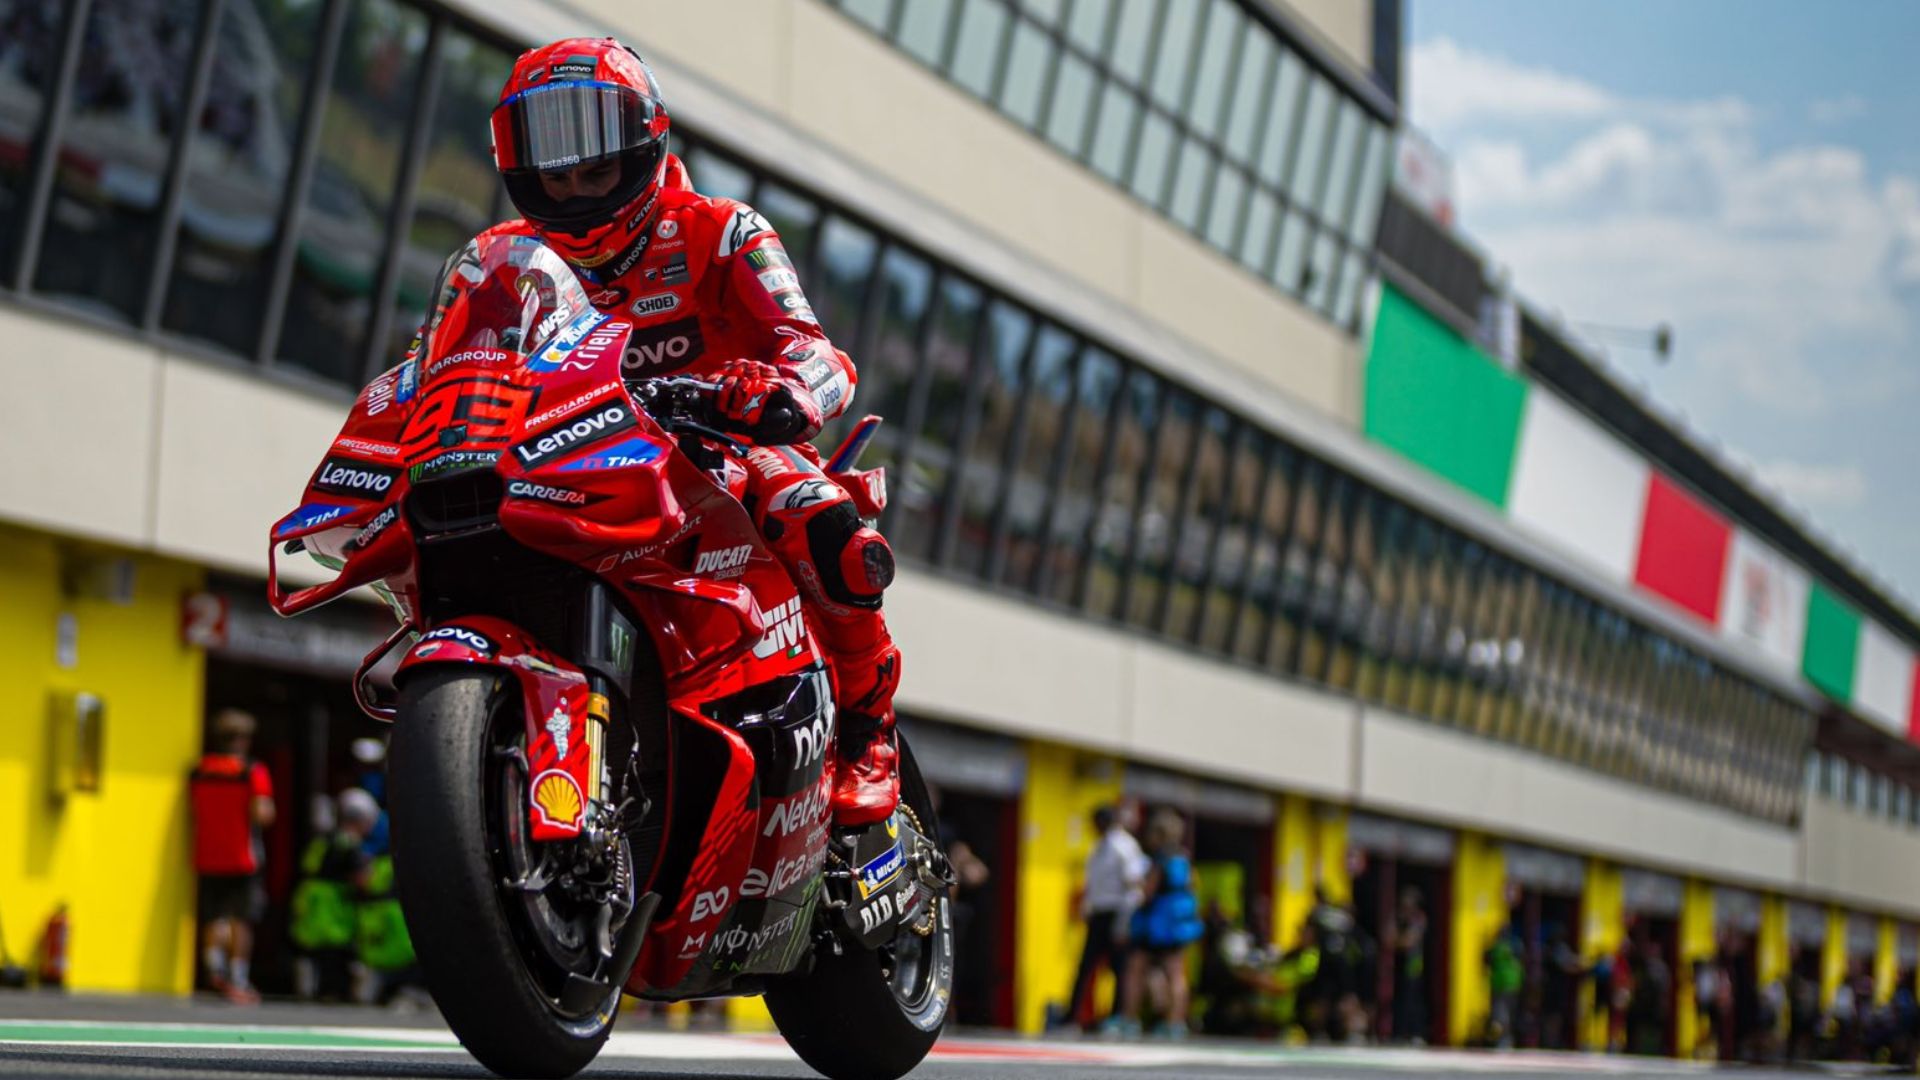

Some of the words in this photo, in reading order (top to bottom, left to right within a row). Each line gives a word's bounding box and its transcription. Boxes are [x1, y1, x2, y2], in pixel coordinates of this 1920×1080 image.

[553, 65, 592, 73] Lenovo
[538, 154, 580, 169] Insta360
[613, 236, 648, 277] Lenovo
[537, 303, 571, 338] WRS
[637, 296, 675, 313] SHOEI
[621, 336, 690, 369] ovo
[524, 382, 620, 430] FRECCIAROSSA
[518, 408, 624, 462] Lenovo
[318, 462, 392, 492] Lenovo
[509, 482, 586, 504] CARRERA
[305, 507, 341, 527] TIM
[355, 507, 396, 547] CARRERA
[694, 544, 754, 575] DUCATI
[739, 854, 806, 898] elica
